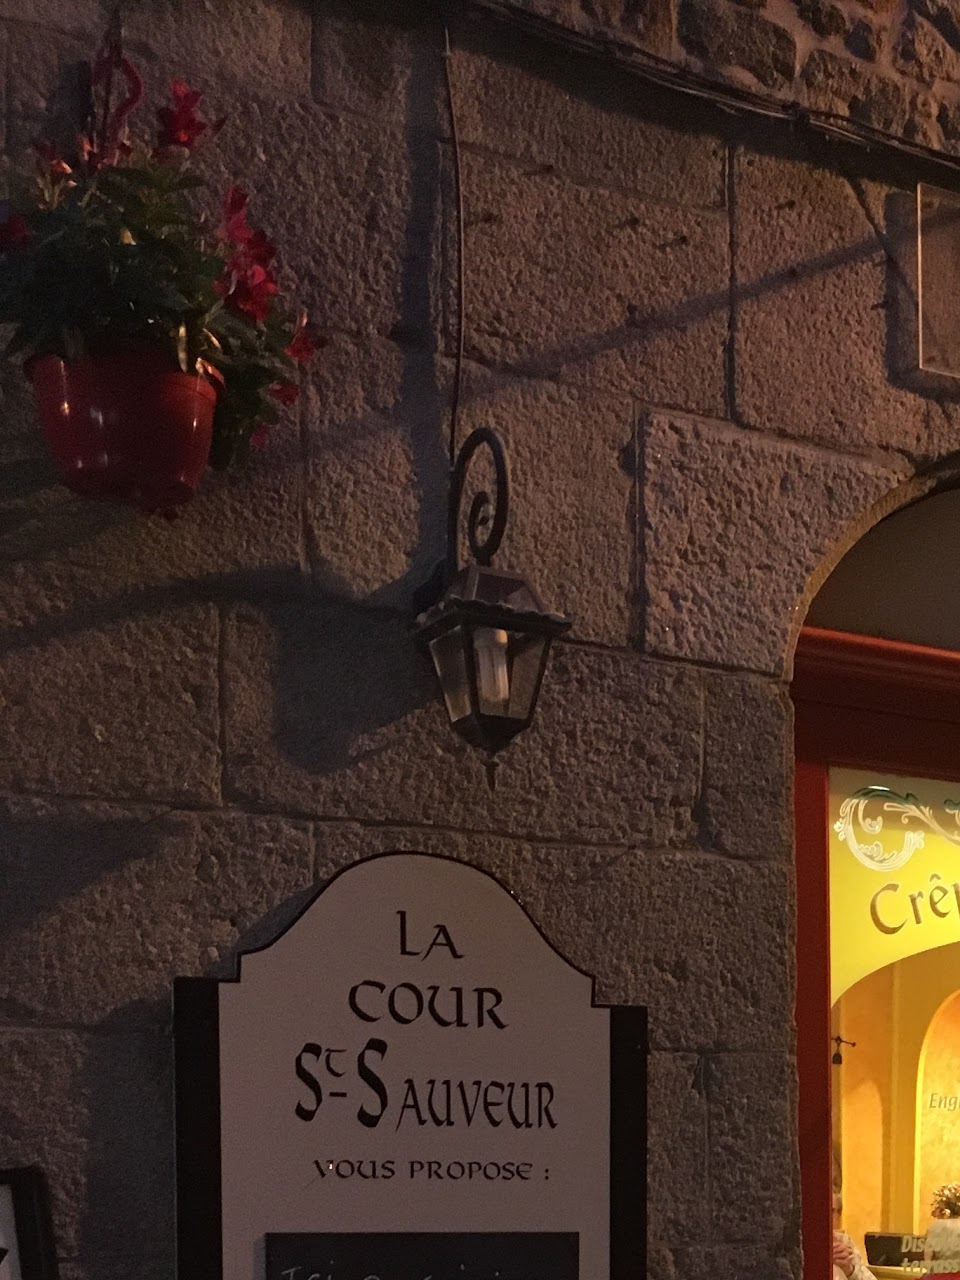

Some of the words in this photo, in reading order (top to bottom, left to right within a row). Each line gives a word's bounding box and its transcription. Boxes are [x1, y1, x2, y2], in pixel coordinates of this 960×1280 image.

[395, 909, 465, 963] LA
[348, 979, 511, 1030] COUR
[313, 1158, 397, 1181] VOUS
[408, 1160, 534, 1182] PROPOSE
